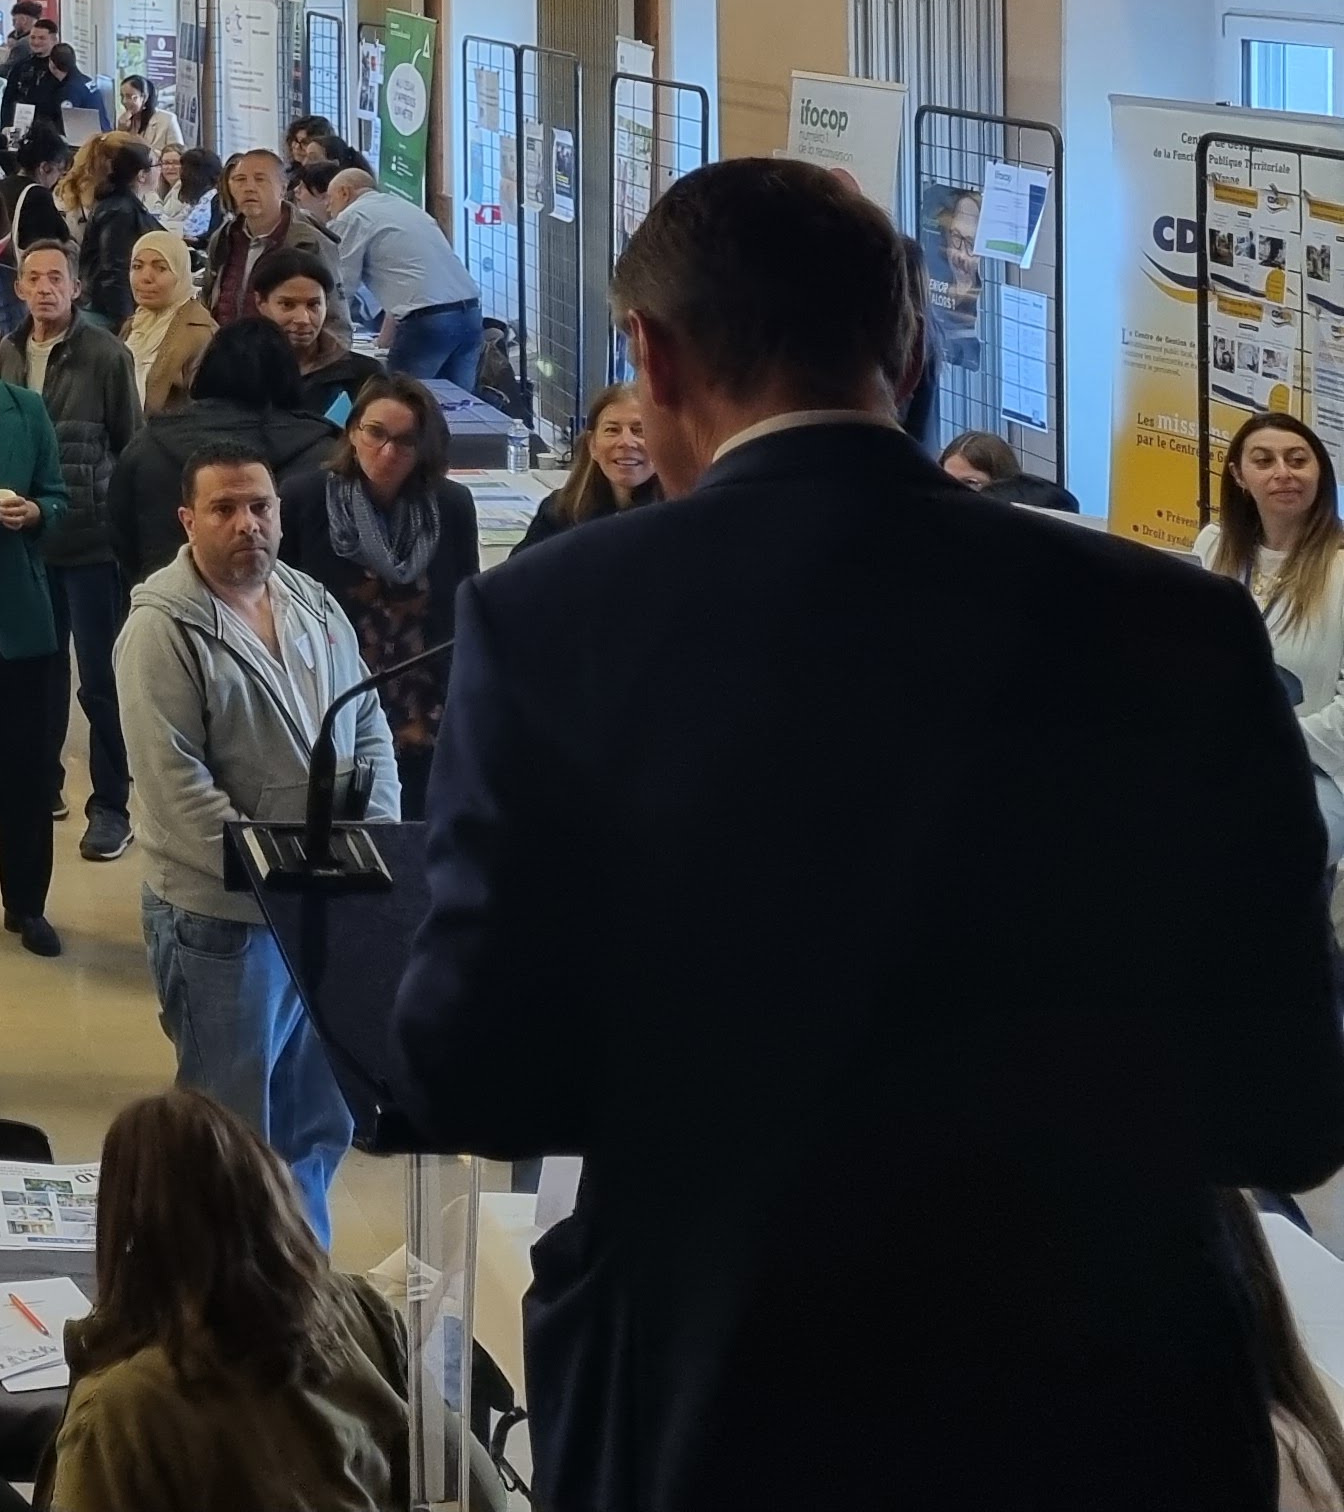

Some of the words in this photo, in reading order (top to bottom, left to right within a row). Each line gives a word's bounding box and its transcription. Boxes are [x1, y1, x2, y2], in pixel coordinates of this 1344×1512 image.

[800, 98, 849, 138] ifocop
[1137, 412, 1155, 428] Les
[1136, 433, 1153, 447] par
[1157, 434, 1167, 448] le
[1143, 525, 1165, 541] Droit
